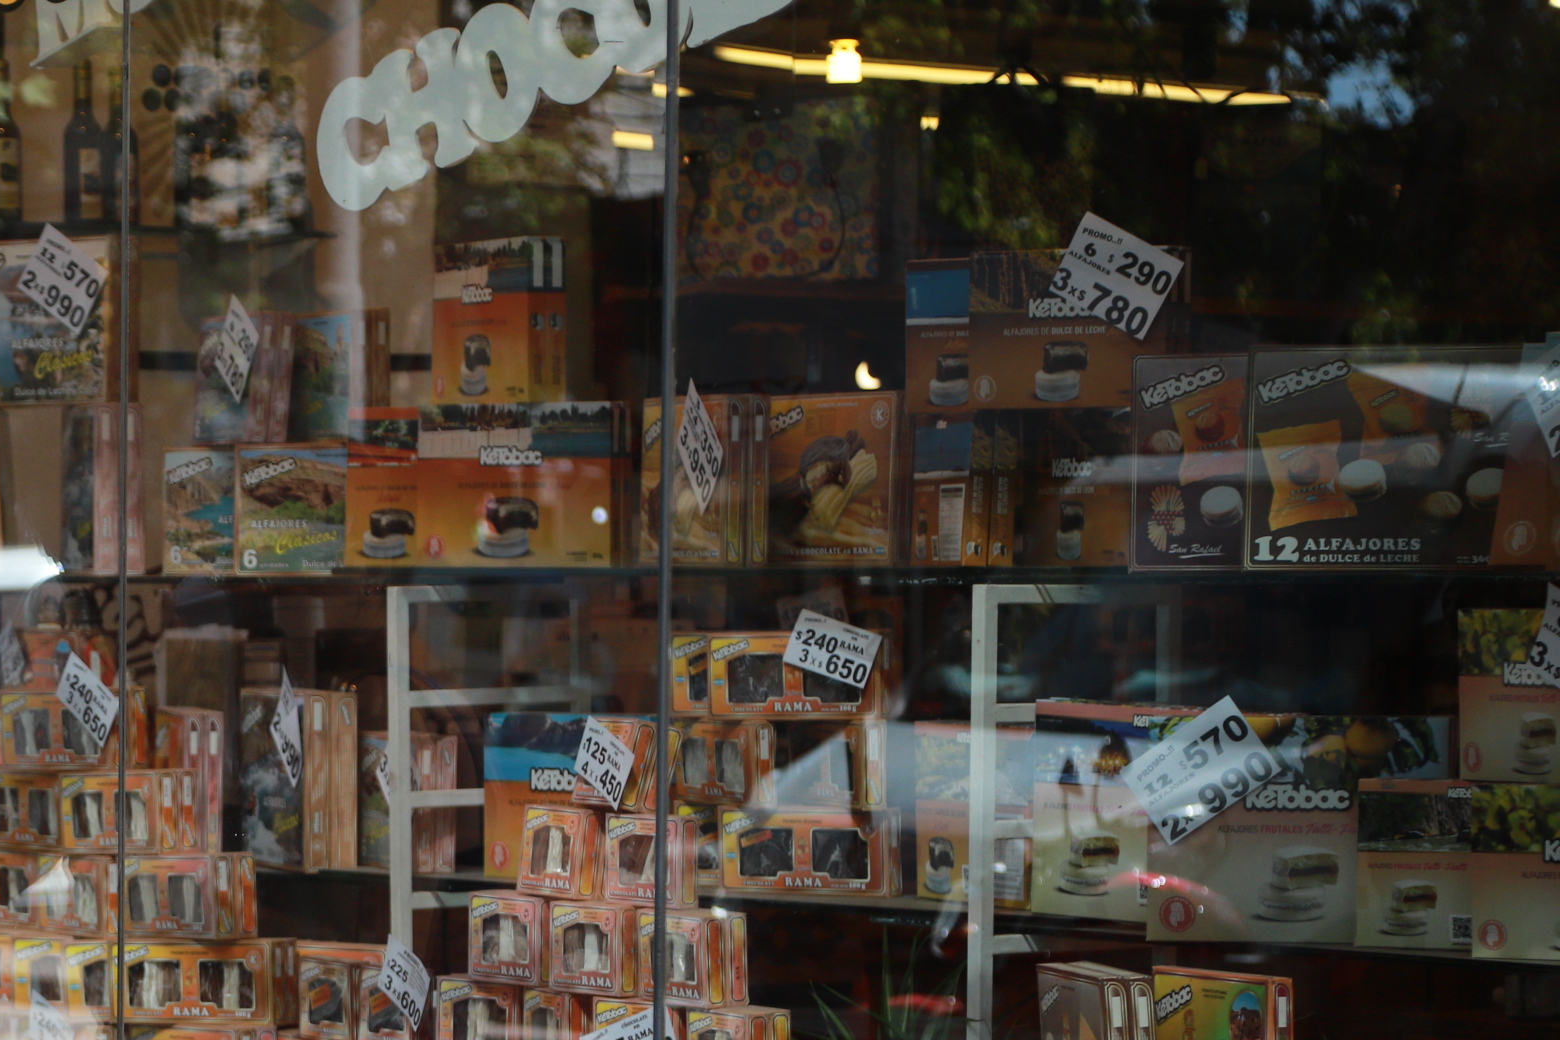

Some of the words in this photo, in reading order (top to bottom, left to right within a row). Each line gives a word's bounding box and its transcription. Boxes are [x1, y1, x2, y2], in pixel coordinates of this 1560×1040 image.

[1084, 243, 1097, 258] 6
[1068, 250, 1112, 276] ALFAJORES
[1003, 328, 1039, 337] ALFAJORES
[1051, 327, 1073, 336] DULCE
[1075, 326, 1084, 335] DE
[1085, 325, 1106, 335] LECHE
[1140, 366, 1224, 409] KeTobac
[1257, 359, 1351, 405] KeTobac
[479, 445, 544, 468] KeTobac
[243, 456, 298, 488] KeTobac
[251, 518, 308, 530] ALFAJORES
[170, 545, 183, 565] 6
[853, 546, 874, 556] RAMA
[1169, 543, 1188, 554] San
[1191, 542, 1223, 557] Rafael
[1253, 535, 1300, 563] 12
[1303, 537, 1421, 551] ALFAJORES
[243, 549, 258, 569] 6
[1303, 554, 1317, 563] de
[1319, 553, 1357, 563] DULCE
[1360, 554, 1375, 563] de
[1377, 553, 1420, 563] LECHE
[795, 629, 838, 654] $240
[839, 640, 864, 656] RAMA
[712, 640, 750, 661] KeTobac
[799, 649, 808, 663] 3
[1529, 641, 1548, 668] 3
[774, 701, 813, 712] RAMA
[44, 754, 71, 763] RAMA
[583, 736, 606, 765] $125
[607, 754, 621, 772] RAMA
[581, 761, 589, 775] 4
[1144, 773, 1173, 798] 12
[1244, 782, 1352, 812] KeTobac
[526, 813, 549, 830] KeTobac
[1161, 813, 1188, 841] 2
[1217, 824, 1259, 834] ALFAJORES
[1261, 824, 1303, 834] FRUTALES
[609, 822, 636, 840] KeTobac
[545, 877, 570, 890] RAMA
[785, 877, 823, 888] RAMA
[472, 901, 499, 920] KeTobac
[552, 910, 580, 928] KeTobac
[155, 919, 179, 931] RAMA
[500, 965, 531, 978] RAMA
[384, 975, 393, 991] 3
[581, 974, 612, 988] RAMA
[440, 984, 472, 1001] KeTobac
[672, 986, 701, 999] RAMA
[173, 1006, 210, 1017] RAMA
[1154, 984, 1194, 1026] KeTobac
[596, 1005, 628, 1023] KeTobac
